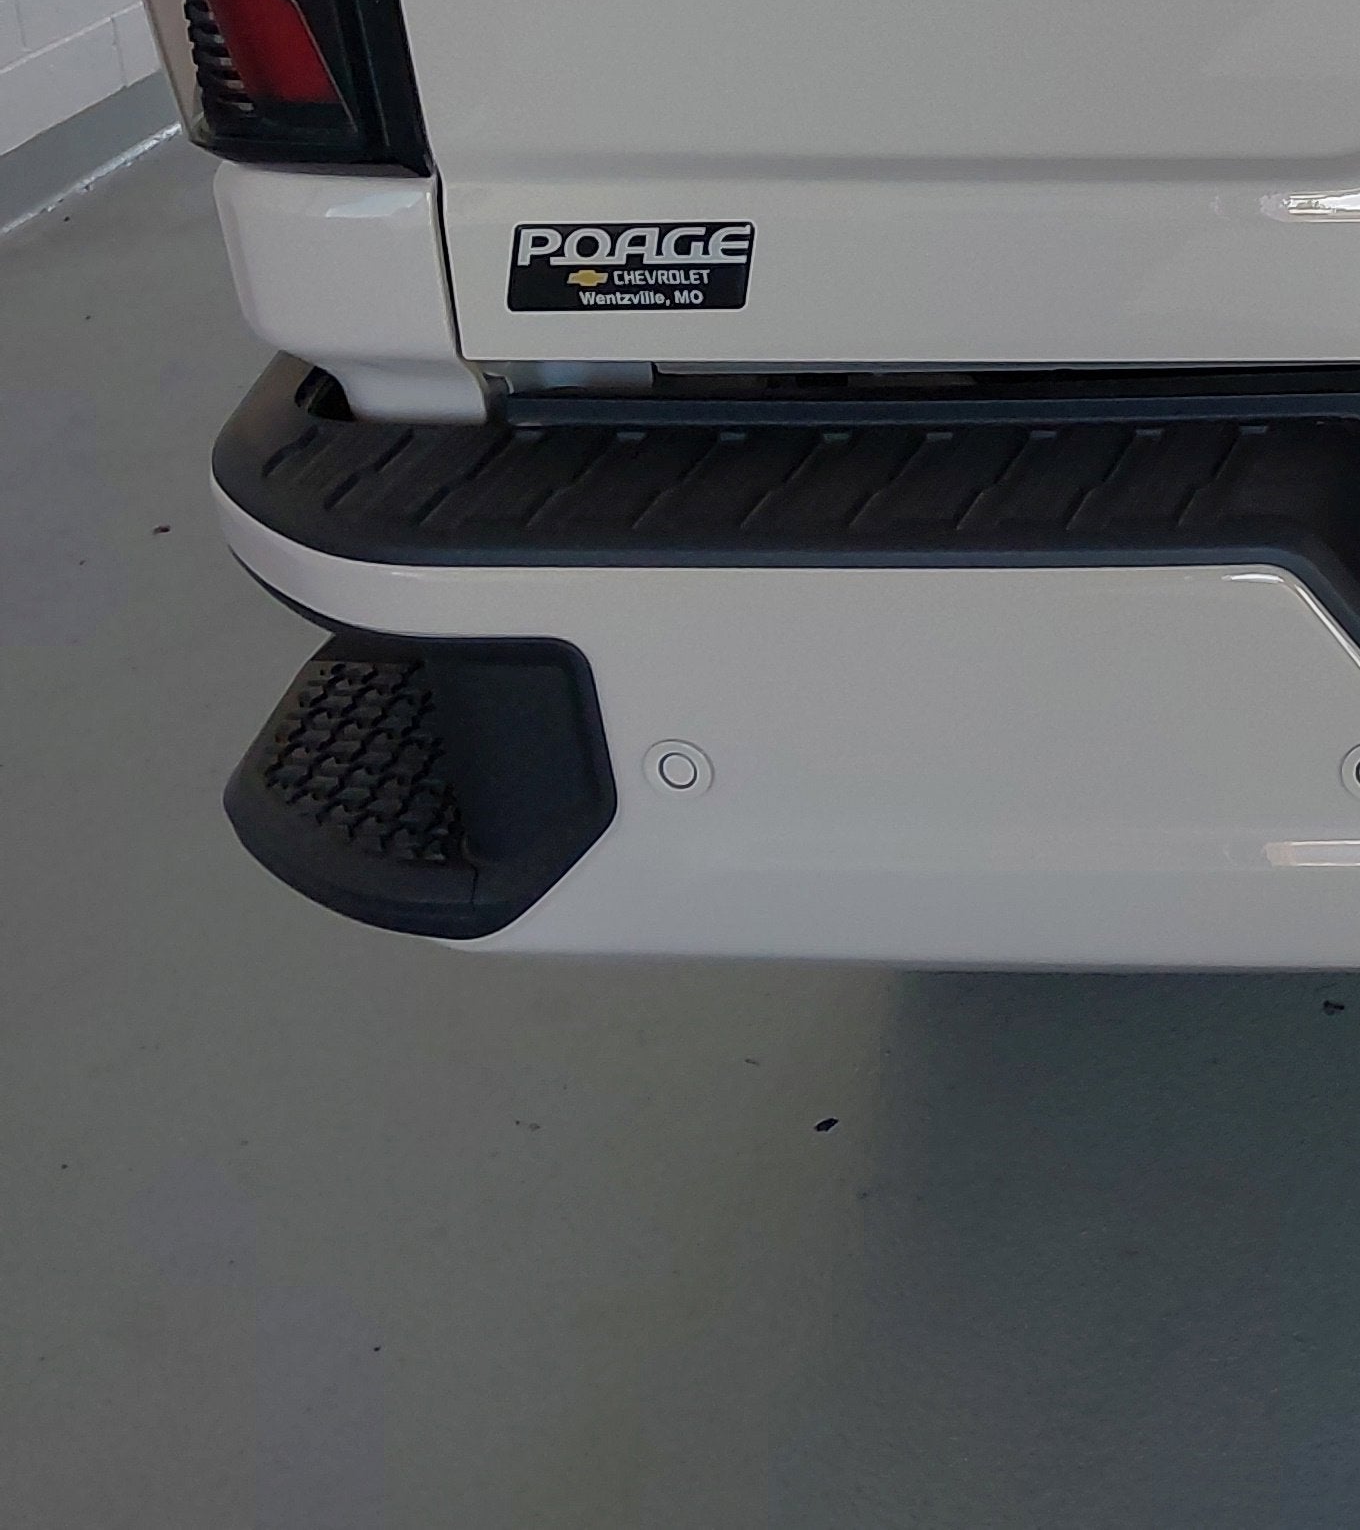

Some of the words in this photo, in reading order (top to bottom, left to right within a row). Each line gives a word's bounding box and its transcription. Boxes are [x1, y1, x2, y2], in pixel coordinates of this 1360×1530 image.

[517, 225, 751, 266] POAGE
[613, 269, 711, 285] CHEVROLET
[579, 290, 671, 307] Wentzville,
[674, 290, 704, 304] MO
